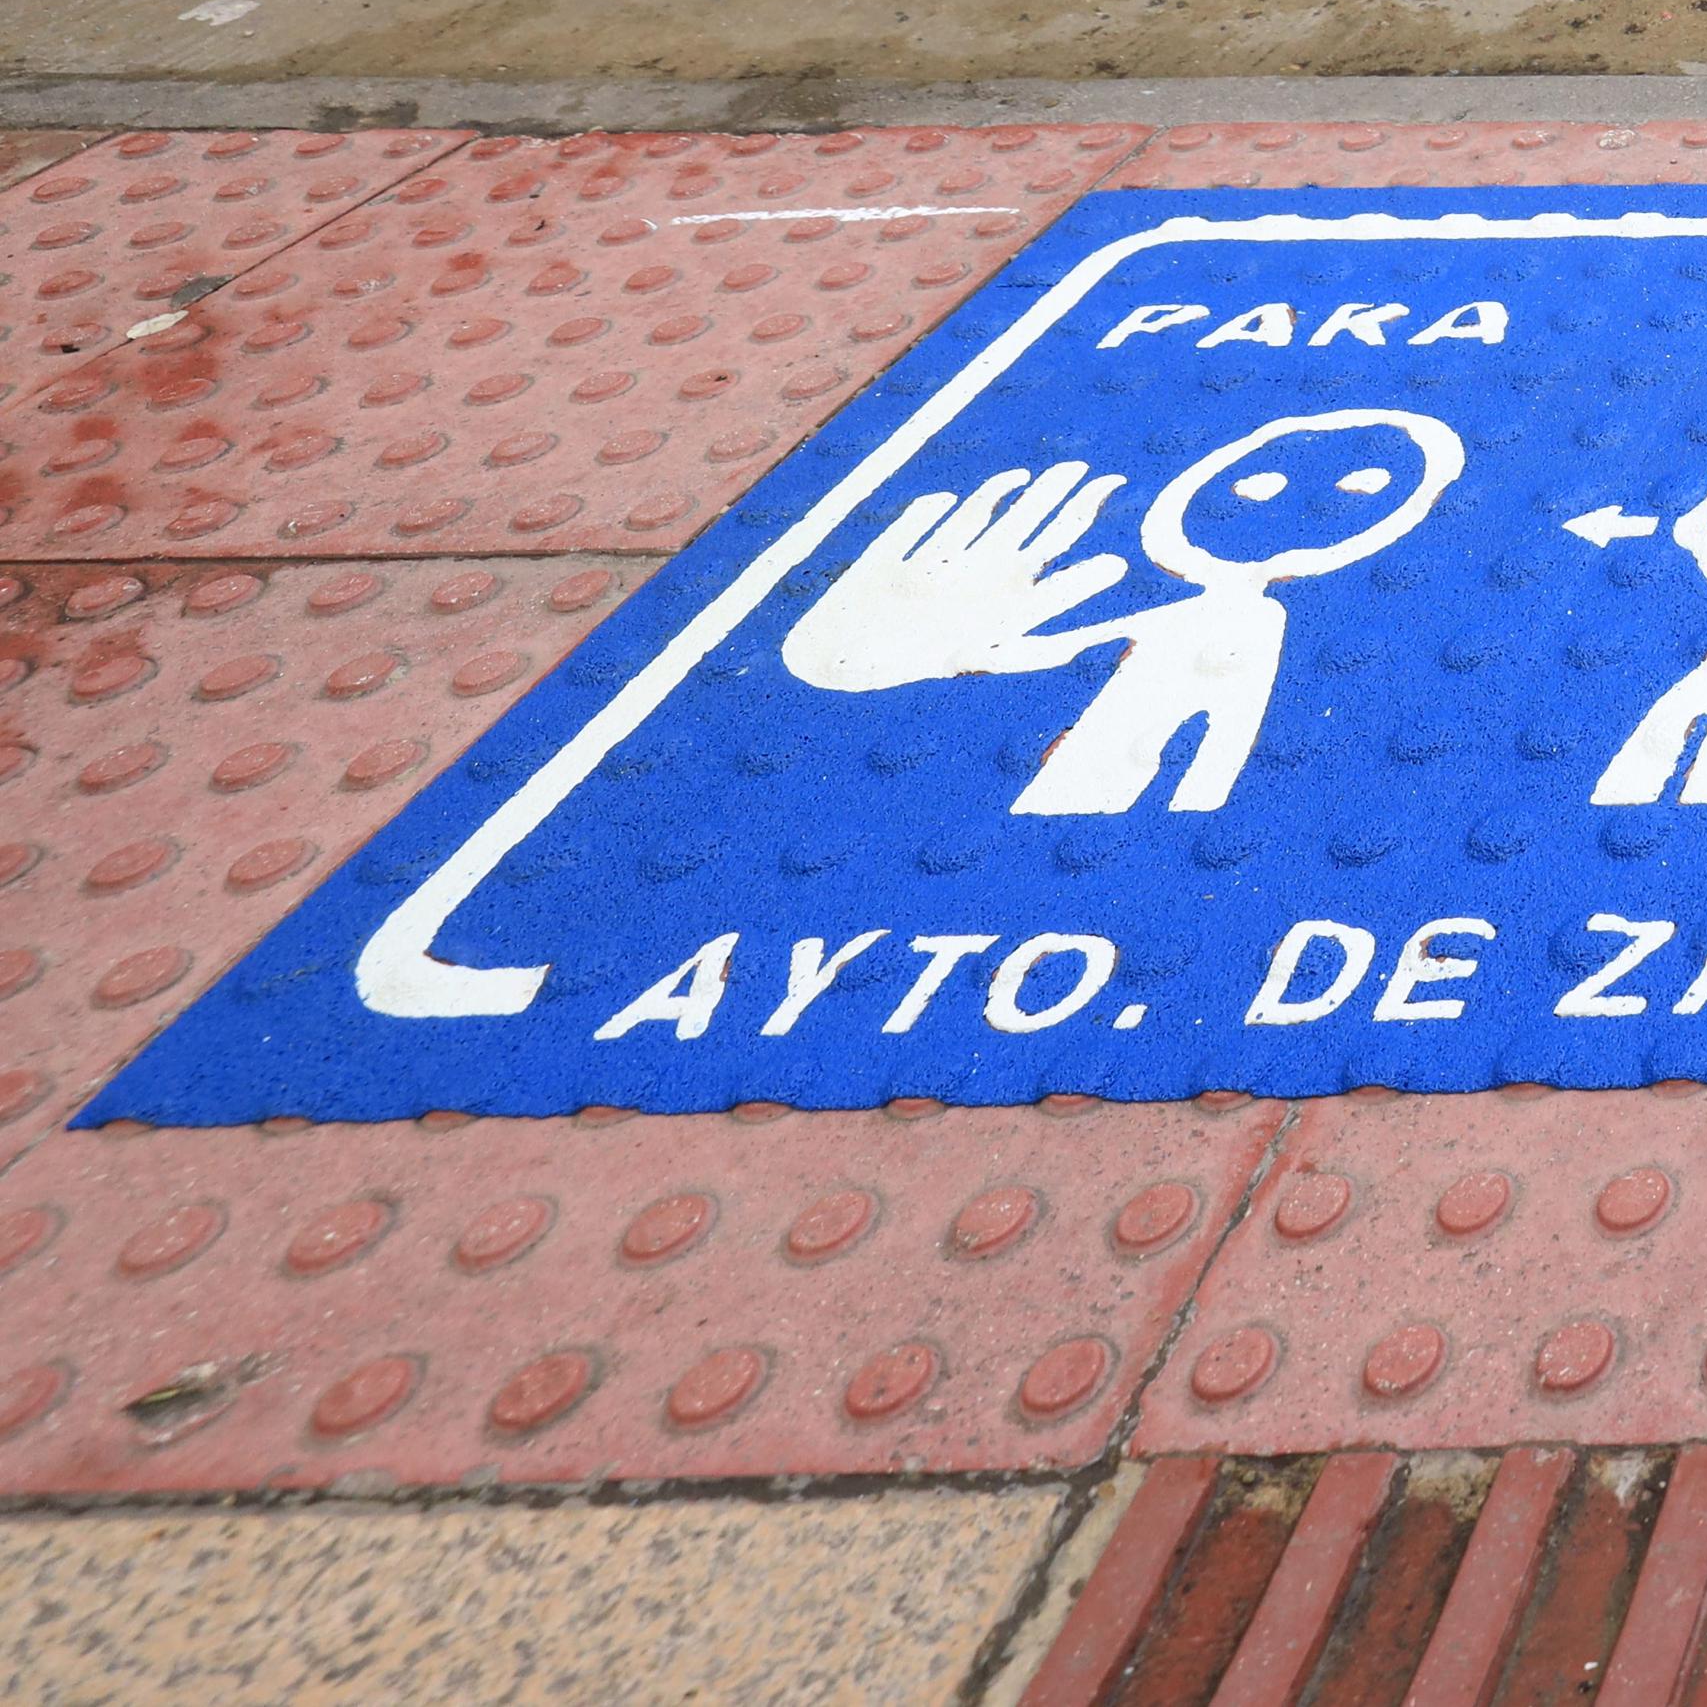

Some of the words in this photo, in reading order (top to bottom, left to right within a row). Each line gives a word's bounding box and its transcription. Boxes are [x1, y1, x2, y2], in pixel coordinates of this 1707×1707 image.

[1095, 301, 1510, 349] PARA
[593, 929, 1148, 1041] AYTO.
[1244, 917, 1497, 1026] DE
